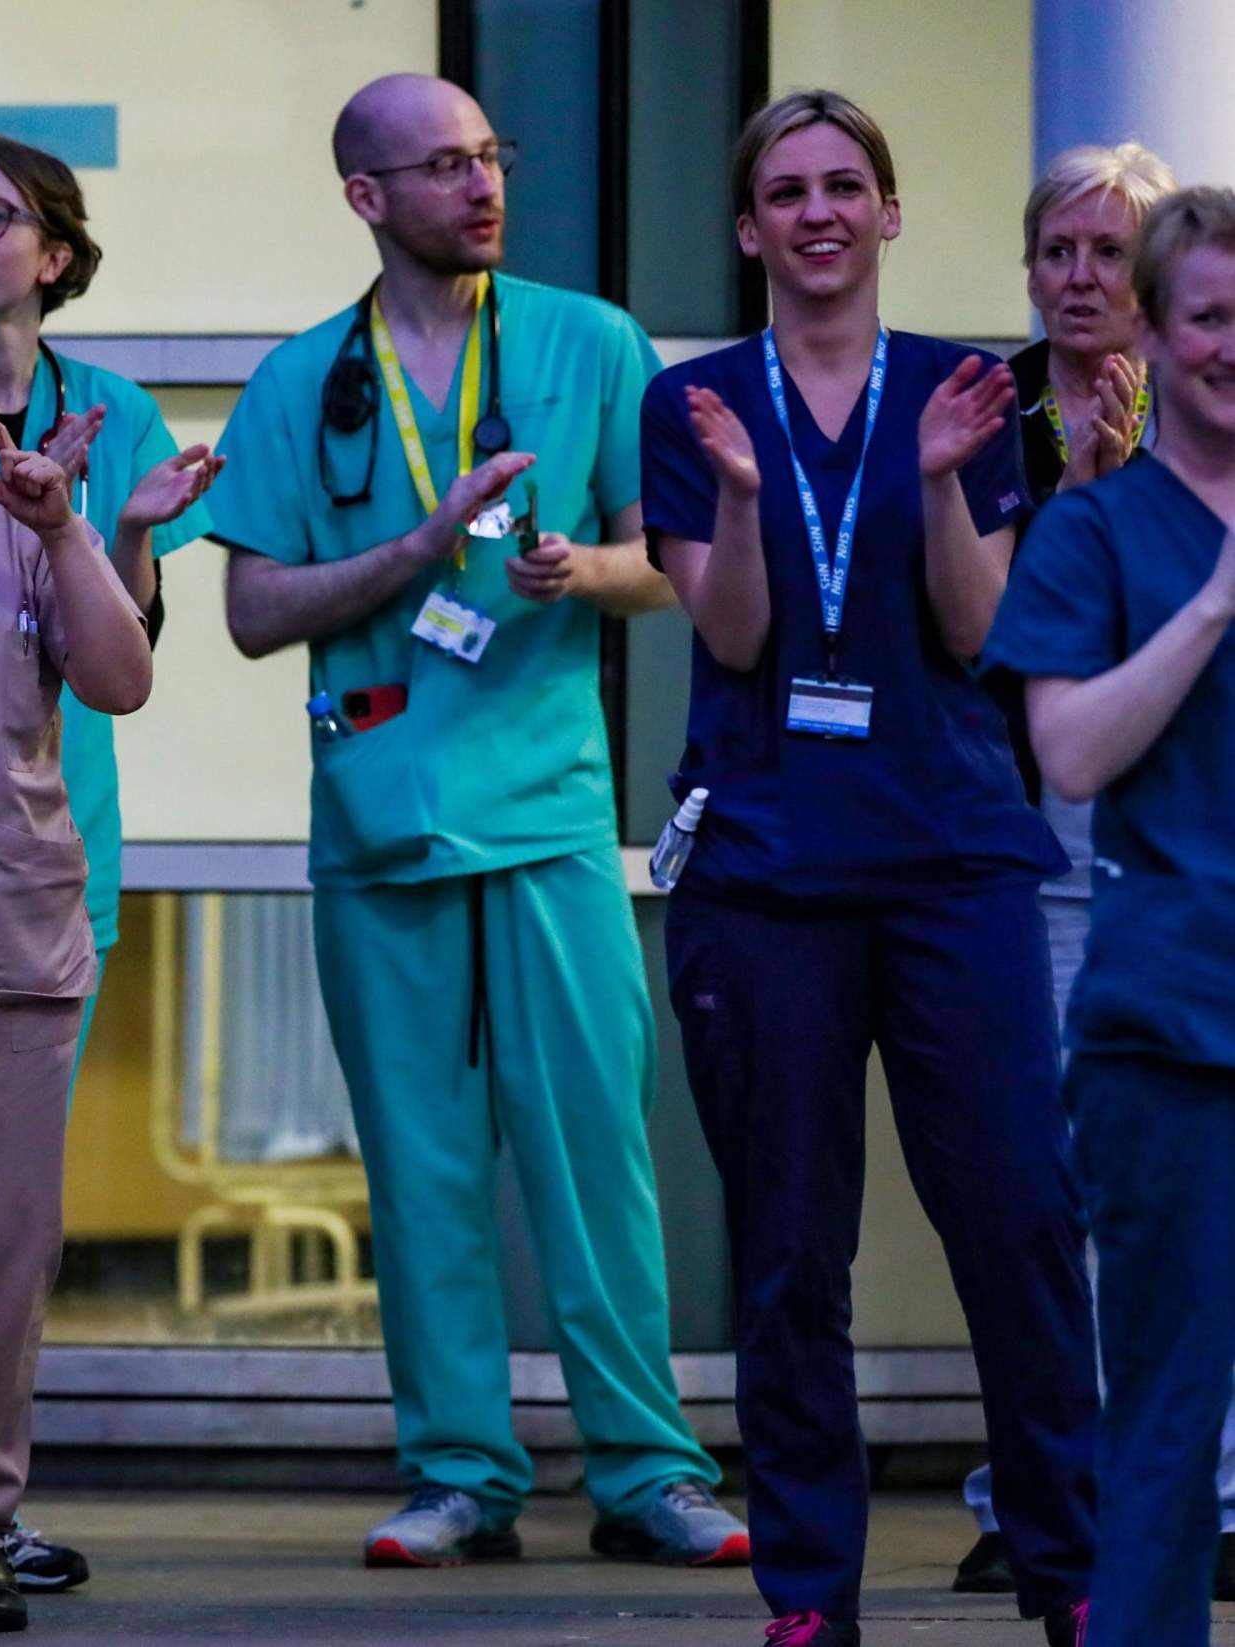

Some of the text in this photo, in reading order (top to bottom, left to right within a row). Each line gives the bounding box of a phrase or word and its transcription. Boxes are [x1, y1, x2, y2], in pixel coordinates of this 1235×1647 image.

[875, 338, 886, 361] NHS
[769, 366, 782, 389] NHS
[870, 366, 884, 391] NHS
[867, 397, 878, 422] NHS
[802, 491, 816, 516] NHS
[843, 497, 855, 522] NHS
[810, 526, 825, 552] NHS
[836, 531, 850, 559] NHS
[817, 563, 831, 590] NHS
[830, 567, 844, 595] NHS
